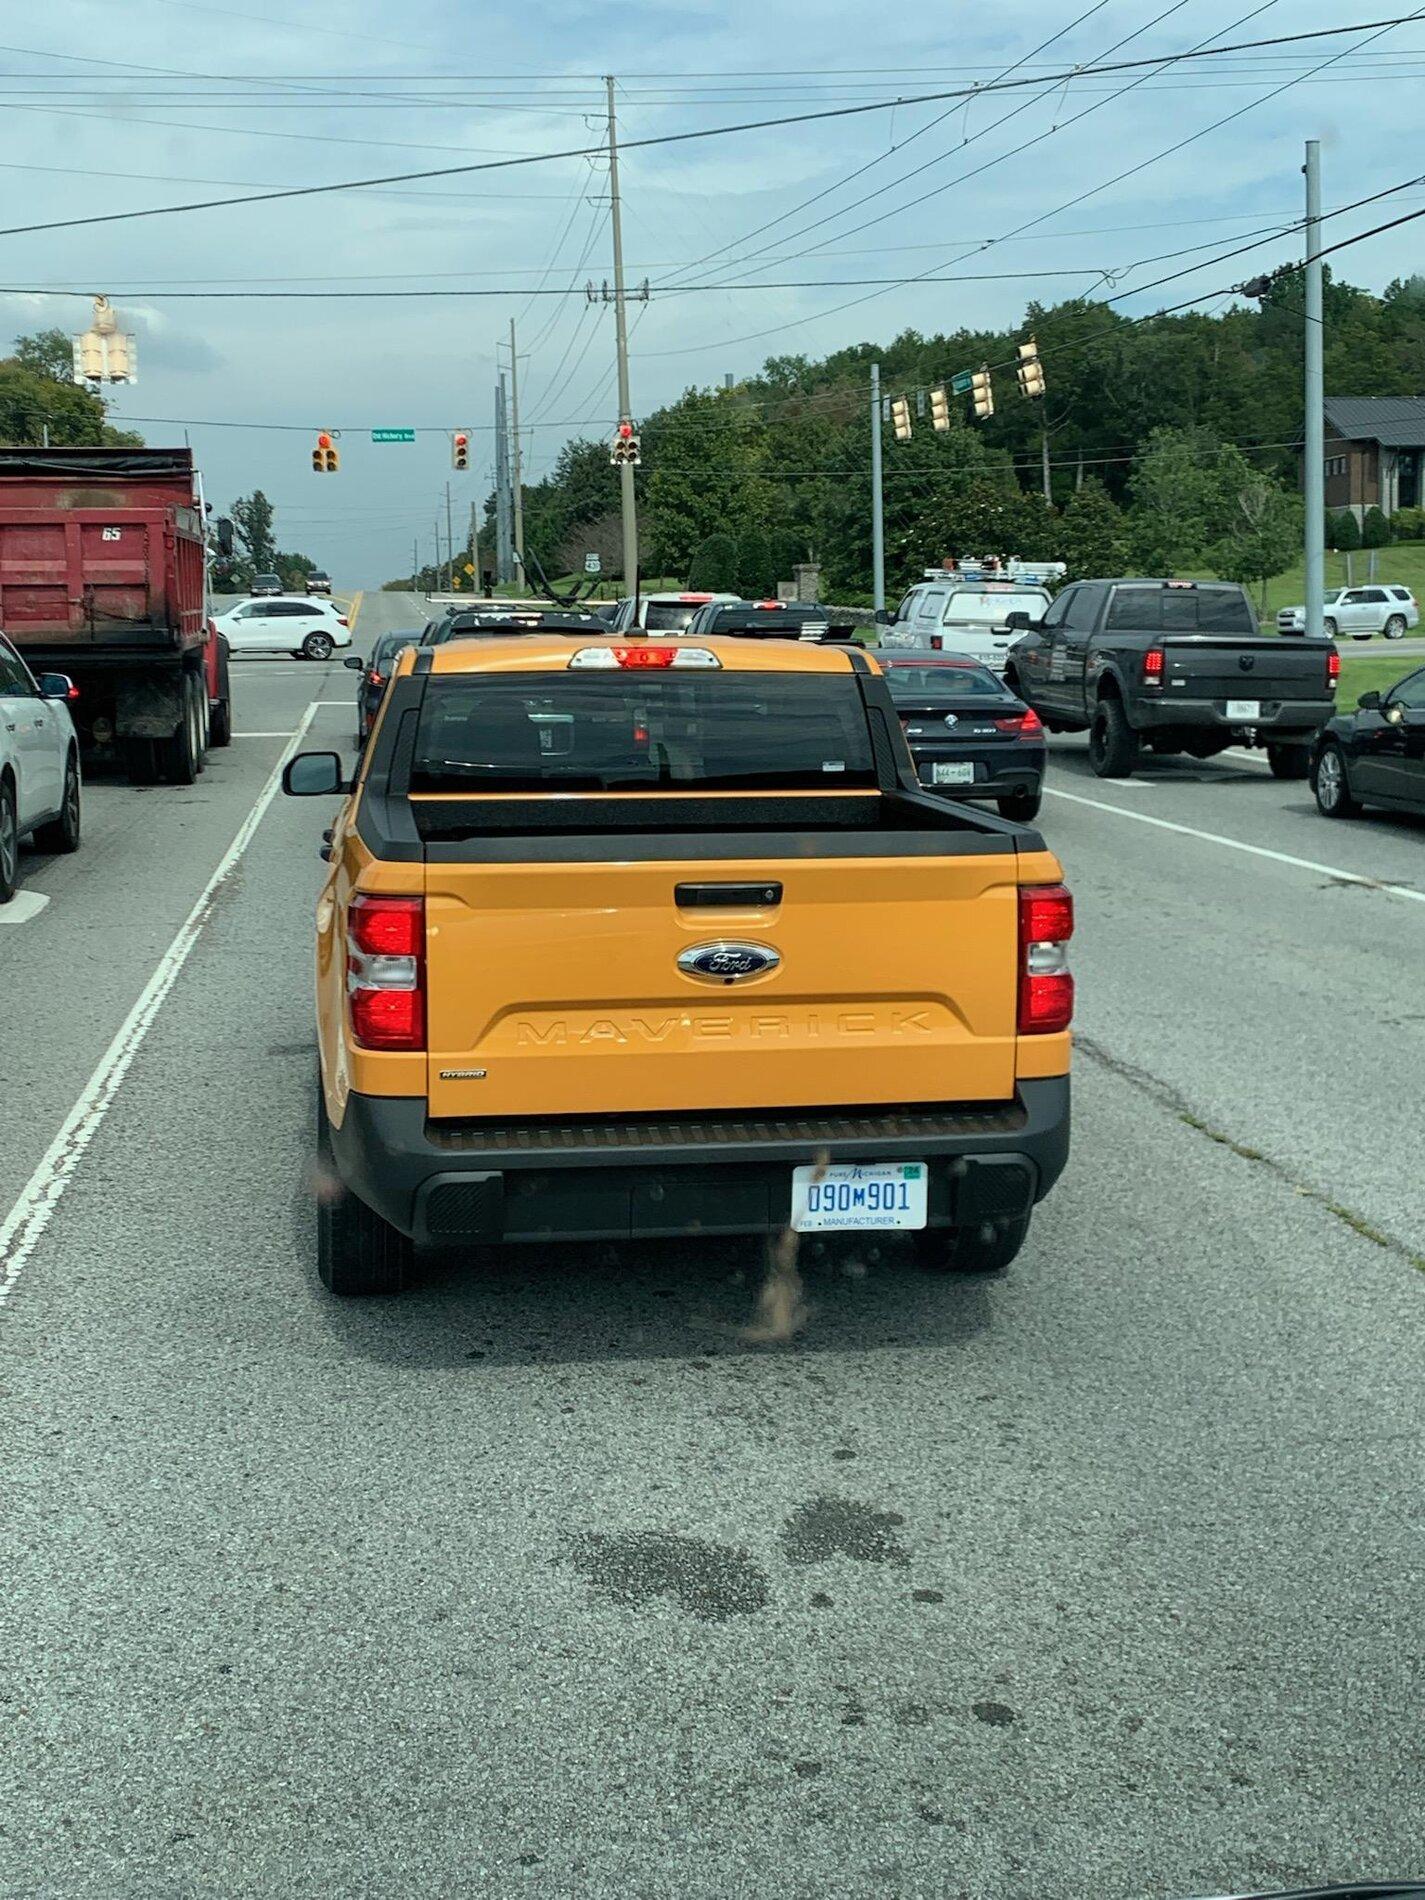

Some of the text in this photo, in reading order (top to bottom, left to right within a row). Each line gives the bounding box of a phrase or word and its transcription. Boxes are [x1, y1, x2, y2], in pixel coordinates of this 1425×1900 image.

[102, 527, 121, 540] 65
[709, 952, 752, 971] Ford
[517, 1011, 932, 1045] MAVERICK
[441, 1070, 485, 1078] HYBRID
[808, 1183, 910, 1212] 090M901
[824, 1216, 895, 1226] MANUFACTURER
